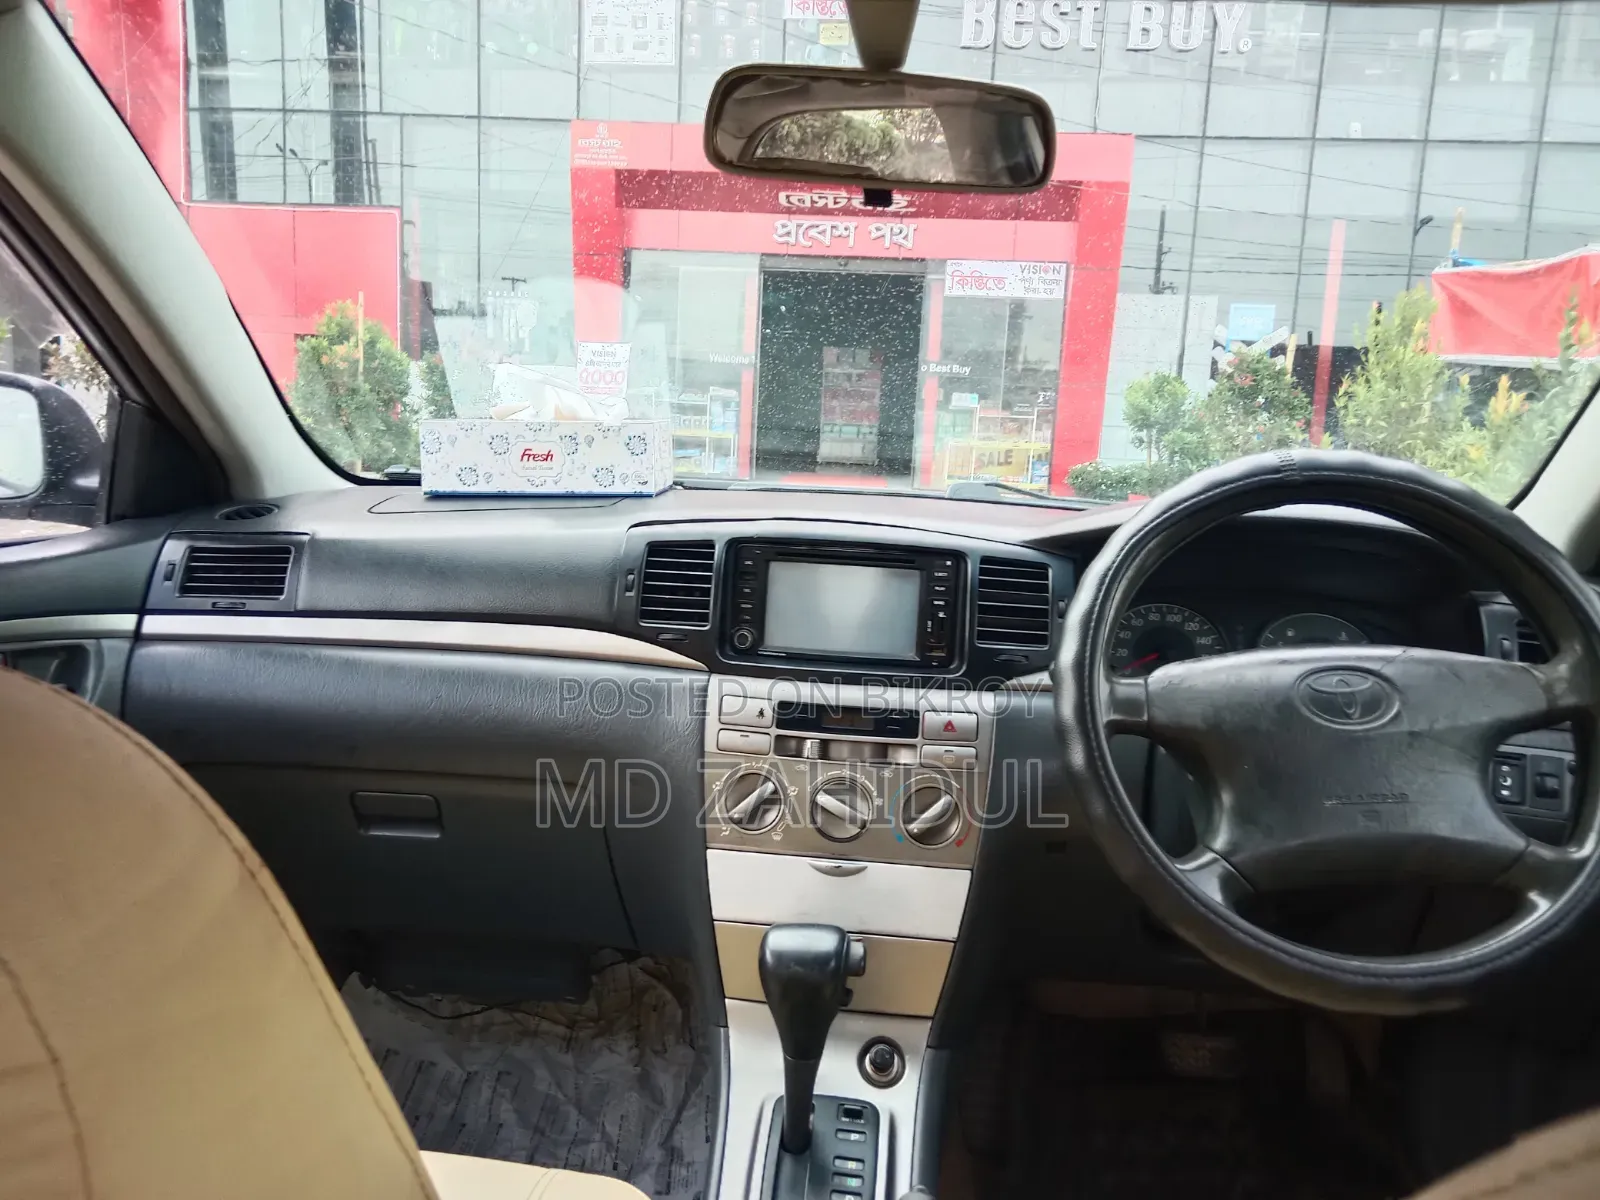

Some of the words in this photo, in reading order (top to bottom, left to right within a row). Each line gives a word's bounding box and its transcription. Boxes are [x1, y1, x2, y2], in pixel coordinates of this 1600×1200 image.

[773, 219, 858, 248] প্রবেশ
[867, 222, 918, 250] পথ
[929, 363, 951, 373] Best
[952, 364, 972, 376] Buy
[520, 448, 554, 462] Fresh
[850, 1133, 860, 1141] P
